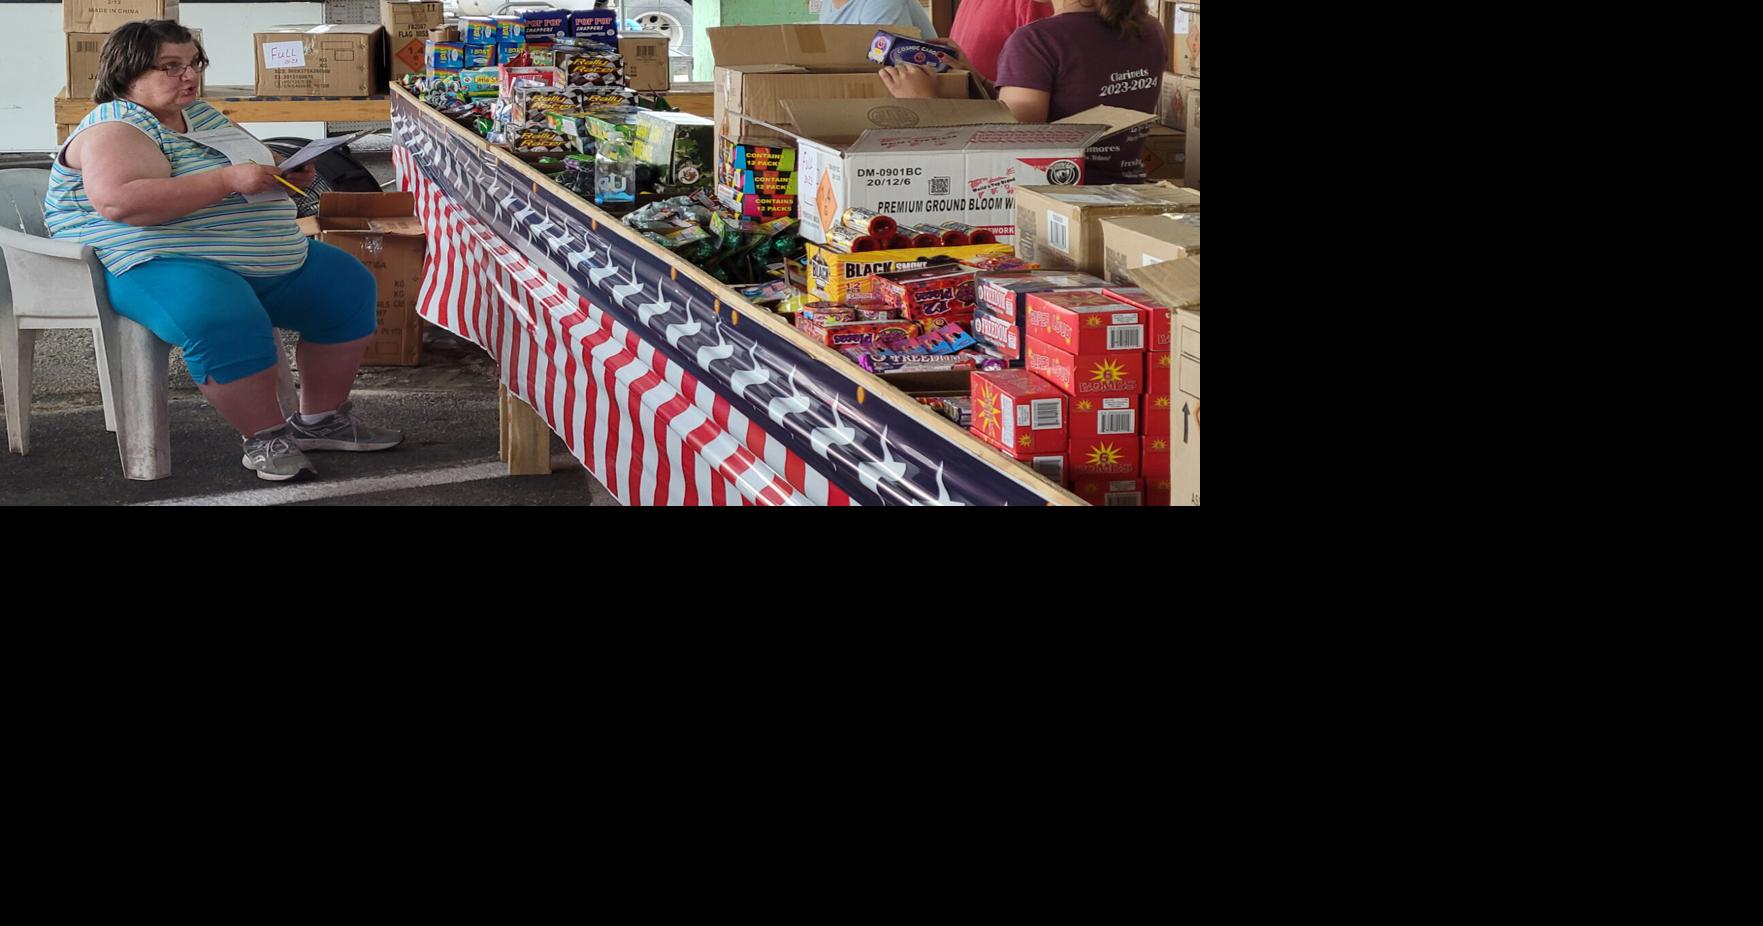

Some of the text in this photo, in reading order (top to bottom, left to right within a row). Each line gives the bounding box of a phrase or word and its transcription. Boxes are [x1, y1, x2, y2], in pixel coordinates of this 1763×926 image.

[544, 18, 562, 26] POP
[575, 17, 612, 26] POP POP
[896, 45, 921, 54] COSMIC
[571, 58, 610, 66] Rally
[1110, 68, 1150, 82] Clarinets
[1099, 76, 1158, 97] 2023-2024
[531, 95, 568, 103] Rally
[588, 95, 624, 103] Rally
[530, 102, 577, 110] Racer
[520, 132, 557, 140] Rally
[857, 167, 923, 178] DM-0901BC
[867, 178, 912, 187] 20/12/6
[877, 200, 924, 214] PREMIUM
[925, 199, 967, 213] GROUND
[968, 197, 1005, 211] BLOOM
[845, 261, 893, 279] BLACK
[983, 283, 1006, 309] FREEDOM
[1031, 309, 1050, 328] SUPER
[981, 317, 1008, 343] FREEDOM
[892, 354, 961, 363] FREEDOM
